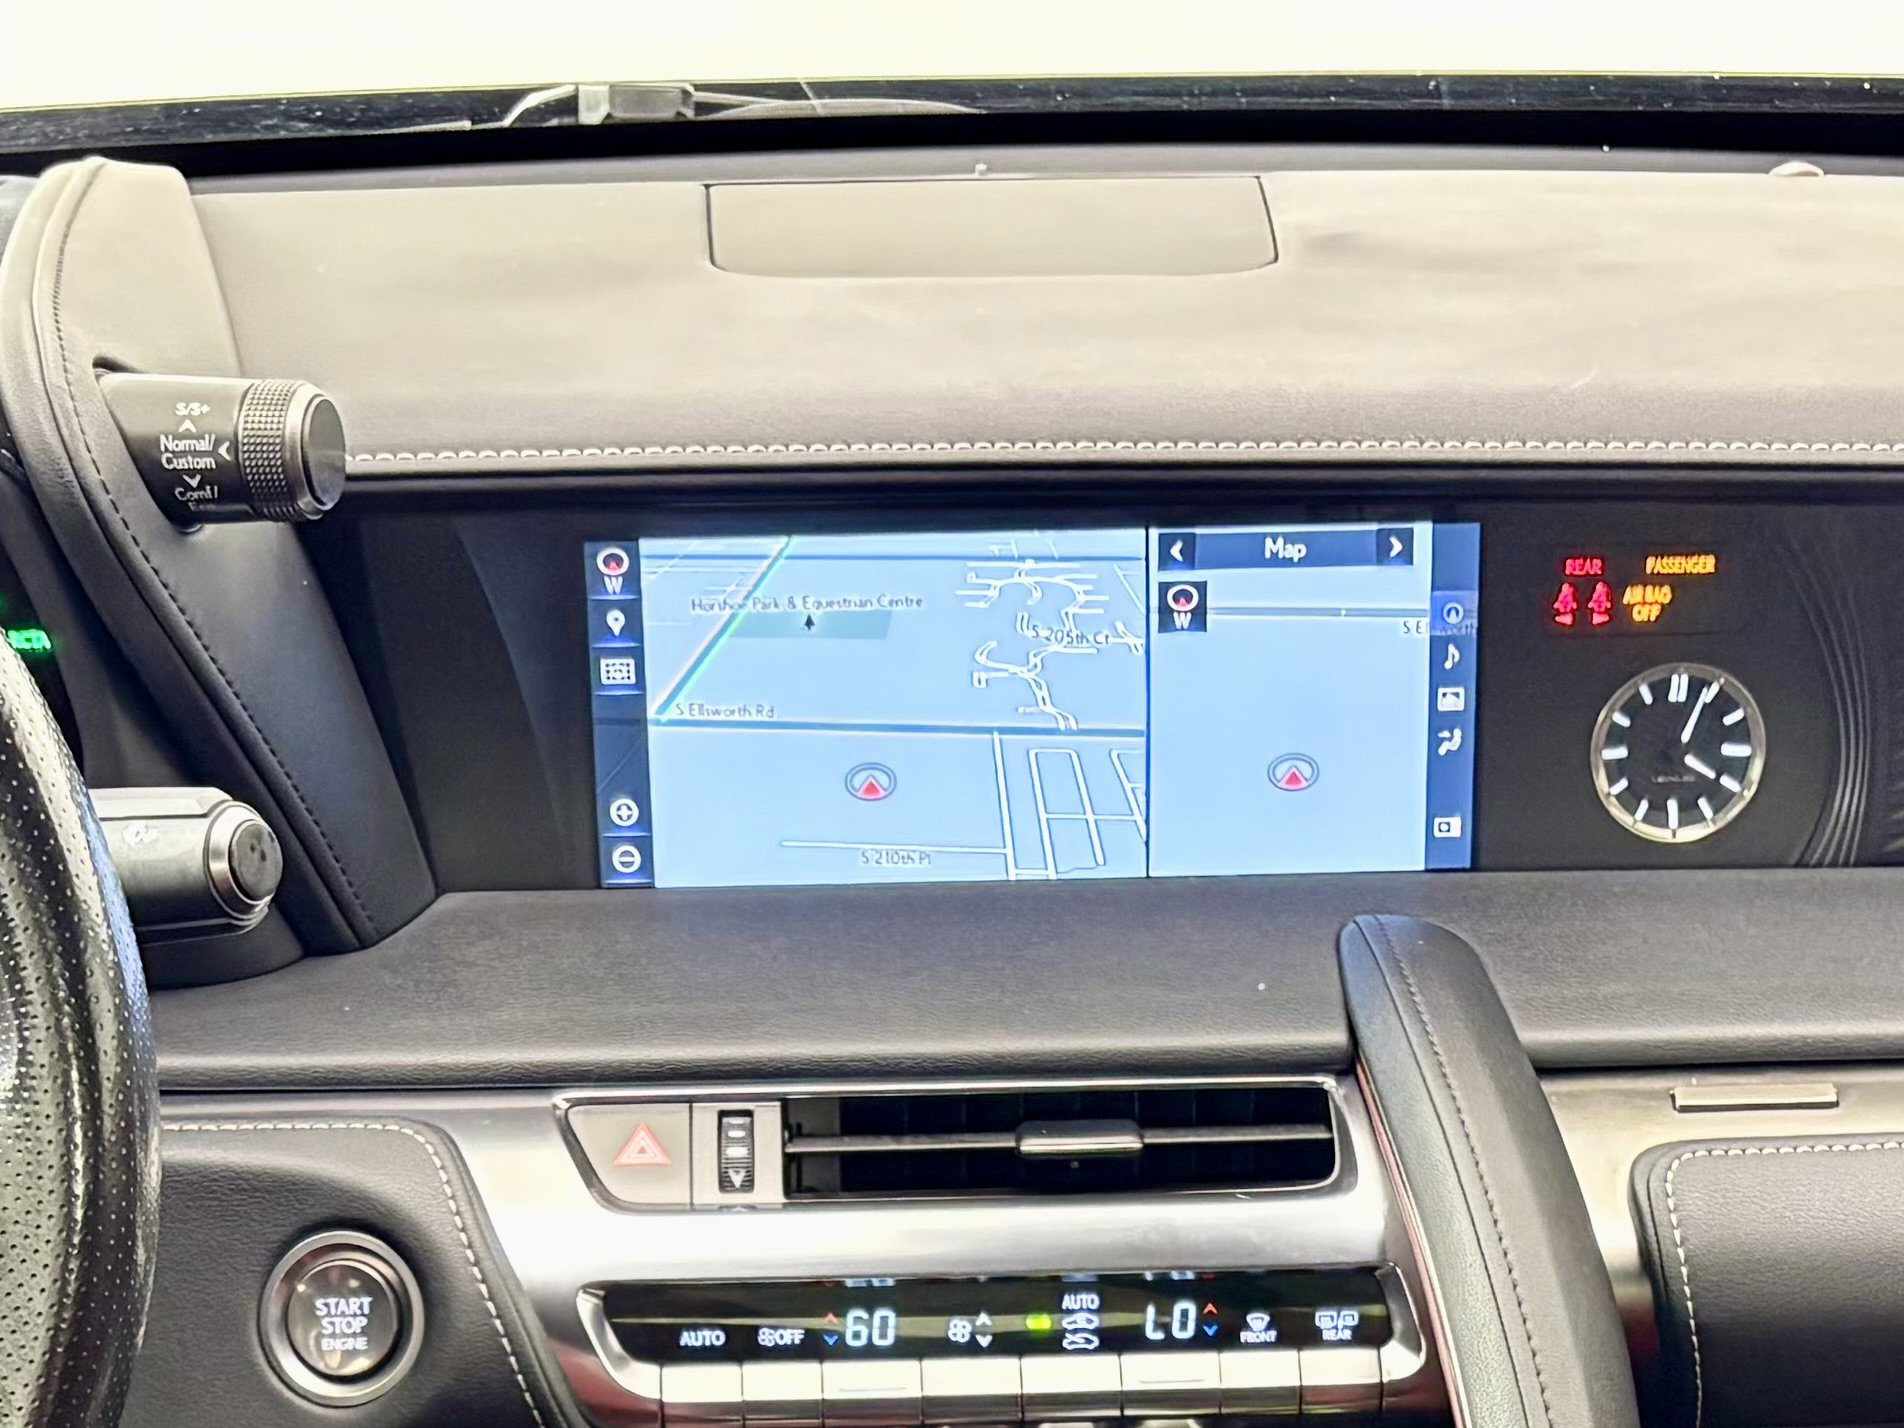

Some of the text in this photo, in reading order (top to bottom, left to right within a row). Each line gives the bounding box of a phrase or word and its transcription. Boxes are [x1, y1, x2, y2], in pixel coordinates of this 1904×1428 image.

[161, 452, 217, 470] Custom
[1263, 535, 1308, 563] Map
[1564, 553, 1717, 576] REAR PASSENGER
[603, 575, 624, 595] W
[787, 595, 797, 610] &
[876, 593, 923, 609] Centre
[1173, 611, 1192, 630] W
[1631, 602, 1663, 622] OFF
[688, 702, 752, 717] Ellsworth
[314, 1297, 374, 1317] START
[1061, 1294, 1100, 1311] AUTO
[320, 1316, 369, 1336] STOP
[679, 1327, 727, 1348] AUTO
[774, 1328, 806, 1346] OFF
[845, 1307, 896, 1347] 60
[1239, 1330, 1277, 1345] FRONT
[1322, 1328, 1353, 1342] REAR
[320, 1336, 369, 1352] ENGINE
